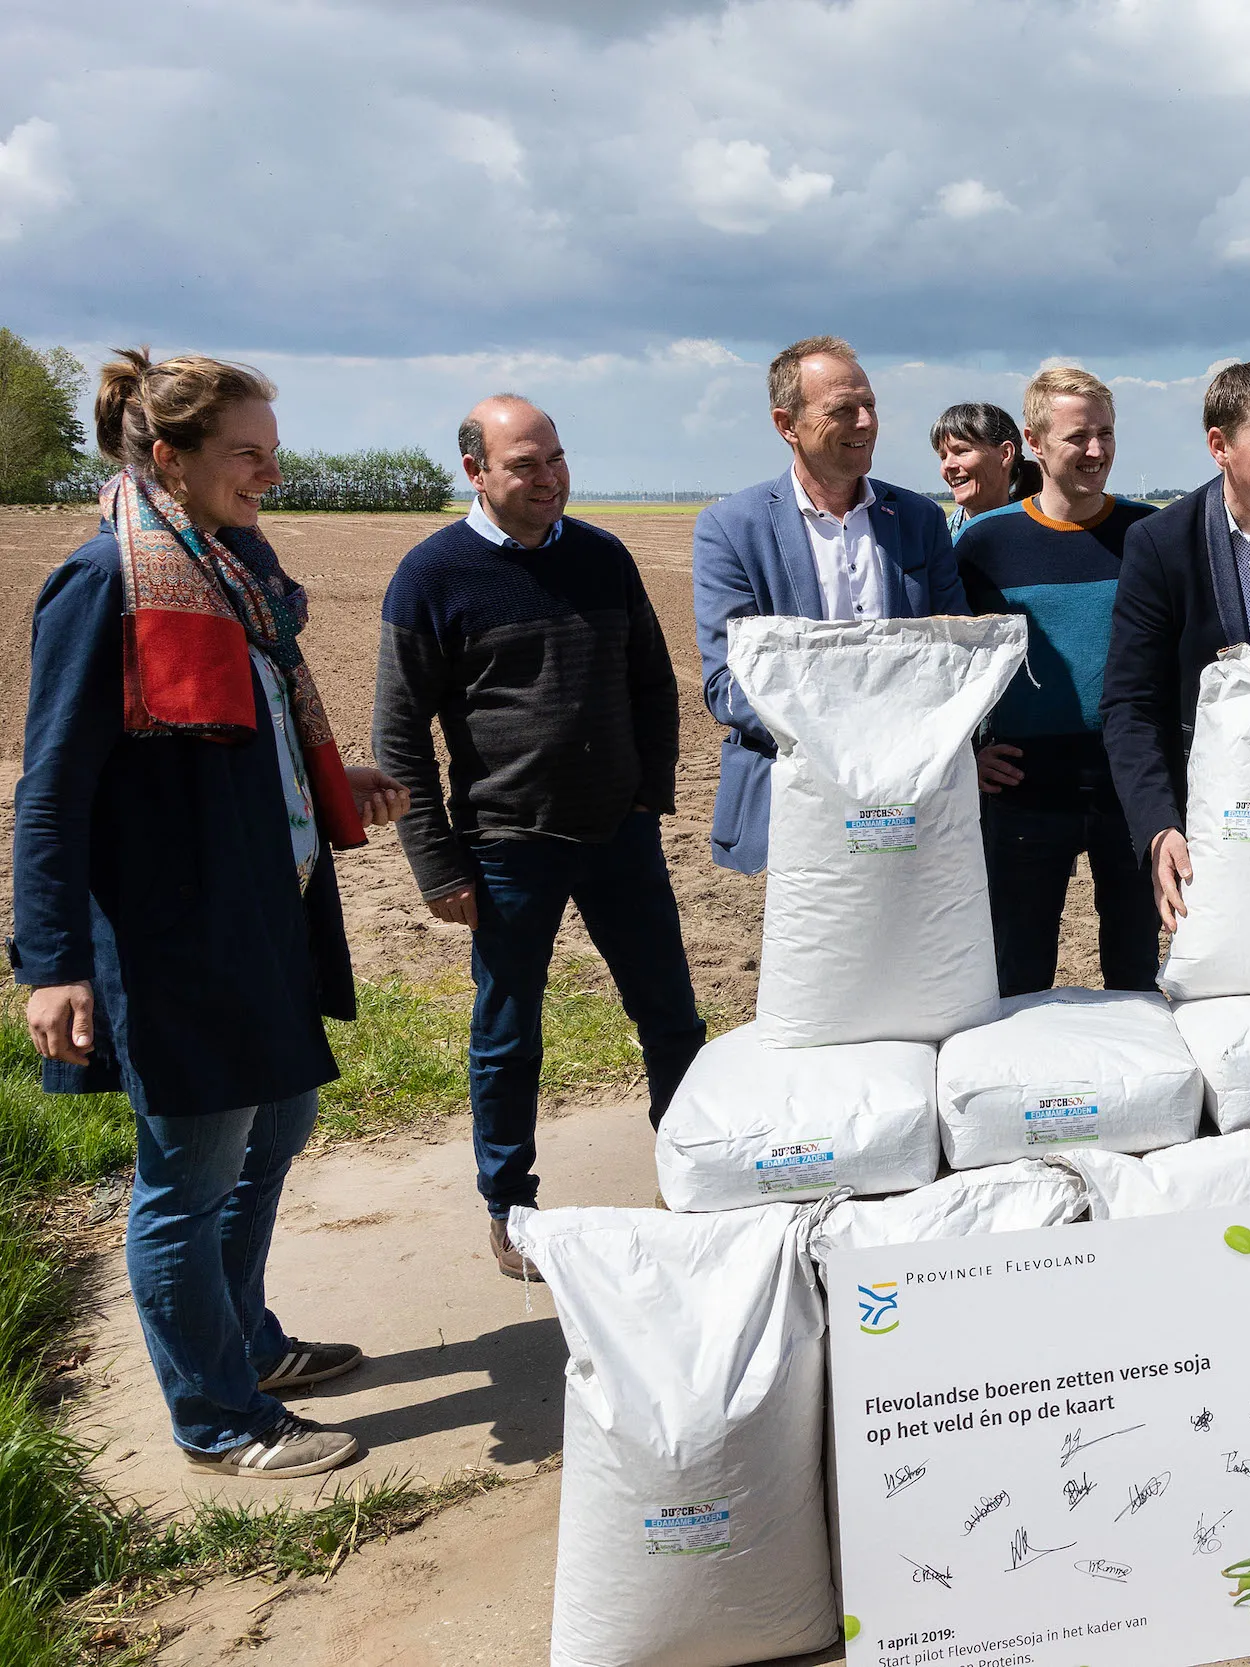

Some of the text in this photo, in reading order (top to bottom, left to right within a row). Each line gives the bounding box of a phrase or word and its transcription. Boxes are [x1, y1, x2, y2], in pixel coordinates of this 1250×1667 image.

[851, 818, 911, 828] EDAMAME ZADEN
[1031, 1106, 1092, 1119] EDAMAME ZADEN
[762, 1153, 828, 1169] EDAMAME ZADEN
[906, 1253, 1096, 1285] PROVINCIE FLEVOLAND
[865, 1353, 1212, 1415] Flevolandse boeren zetten verse soja
[866, 1394, 1116, 1446] op het veld én op de kaart
[651, 1513, 723, 1528] EDAMAME ZADEN
[877, 1628, 956, 1651] 1 april 2019:
[878, 1616, 1147, 1667] Start pilot FlevoVerseSoja in het kader van
[979, 1653, 1034, 1667] Proteins.
